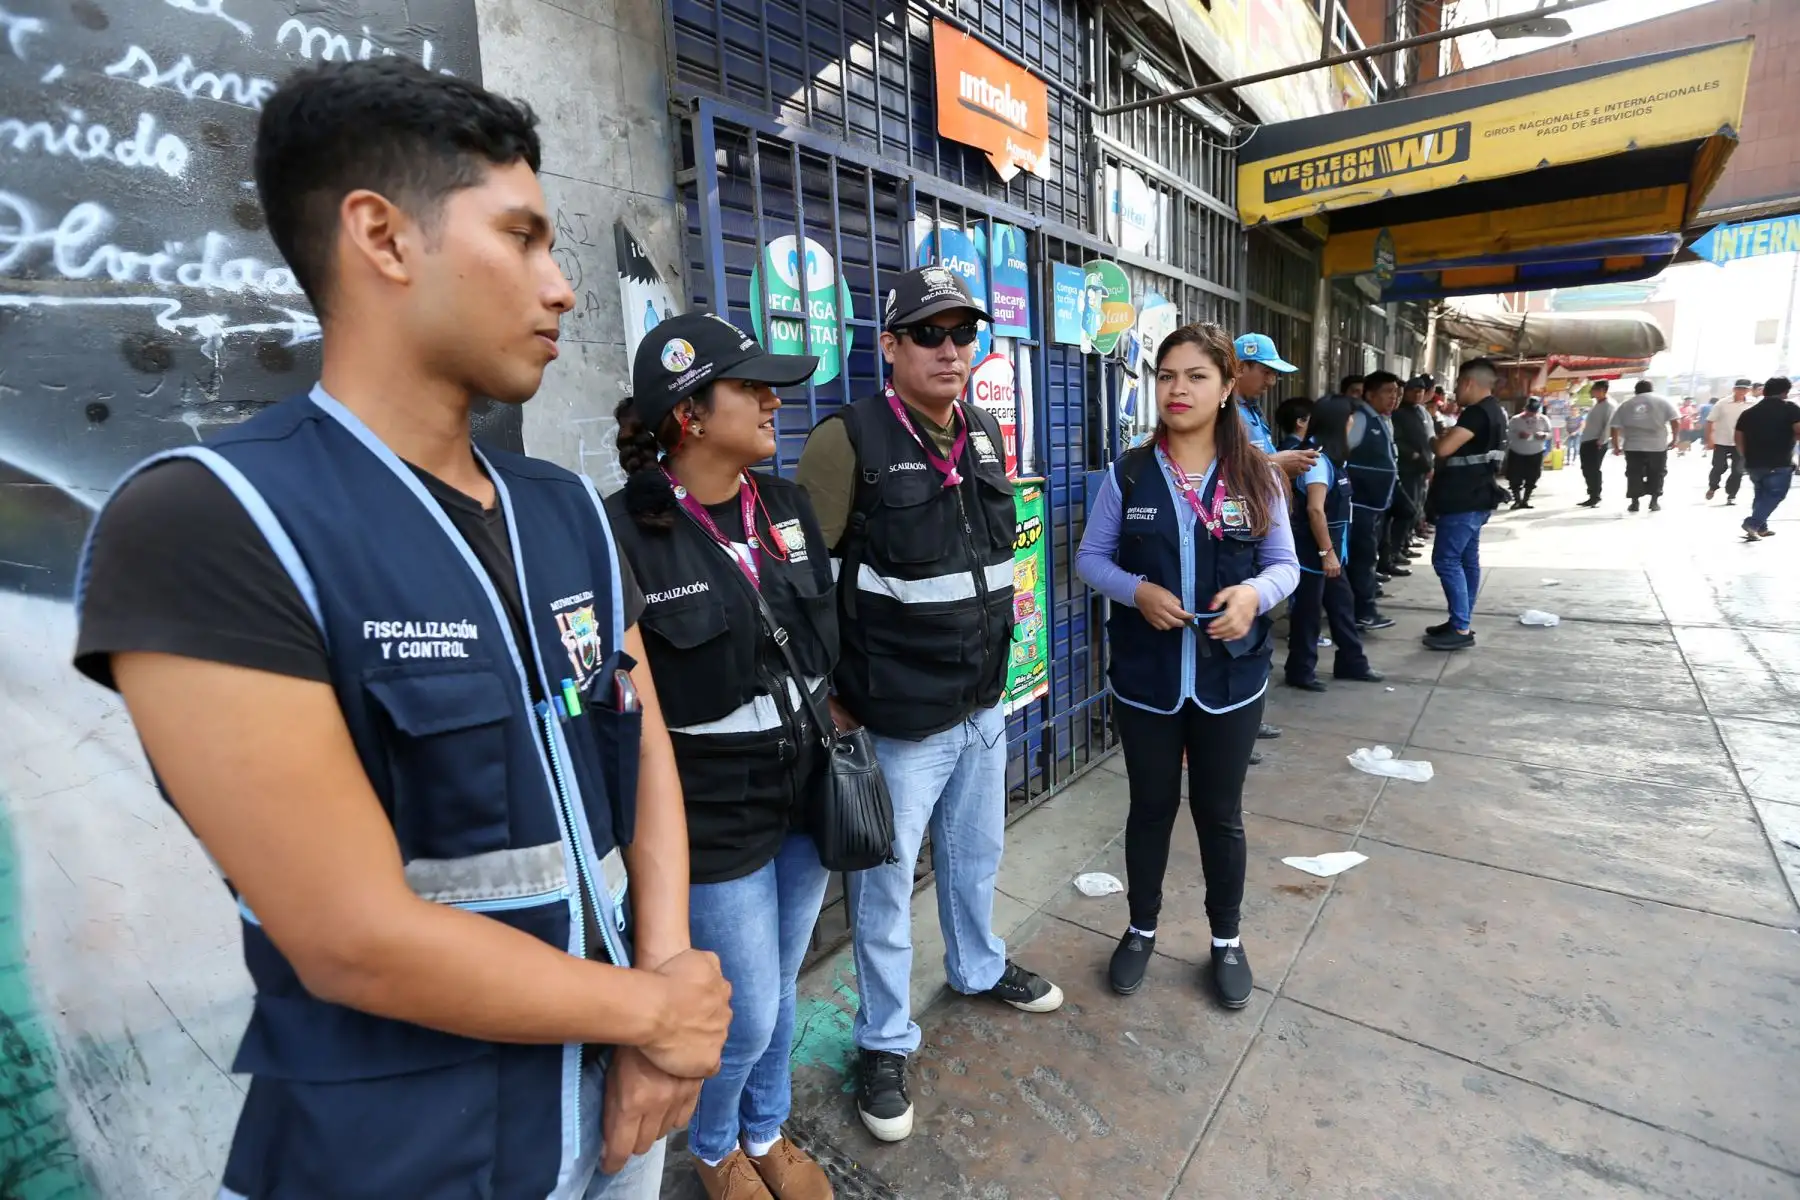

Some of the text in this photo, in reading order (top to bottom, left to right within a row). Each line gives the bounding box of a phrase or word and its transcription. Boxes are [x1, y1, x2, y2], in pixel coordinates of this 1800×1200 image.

[1484, 79, 1721, 138] GIROS NACIONALES E INTERNACIONALES
[1536, 105, 1653, 137] PAGO DE SERVICIOS
[1388, 127, 1458, 172] WU
[1269, 146, 1376, 186] WESTERN
[1300, 162, 1375, 192] UNION
[976, 380, 1013, 401] Claro
[888, 461, 928, 473] SCALIZACIÓN
[646, 581, 710, 605] FISCALIZACIÓN
[363, 619, 478, 640] FISCALIZACIÓN
[381, 641, 470, 660] Y CONTROL
